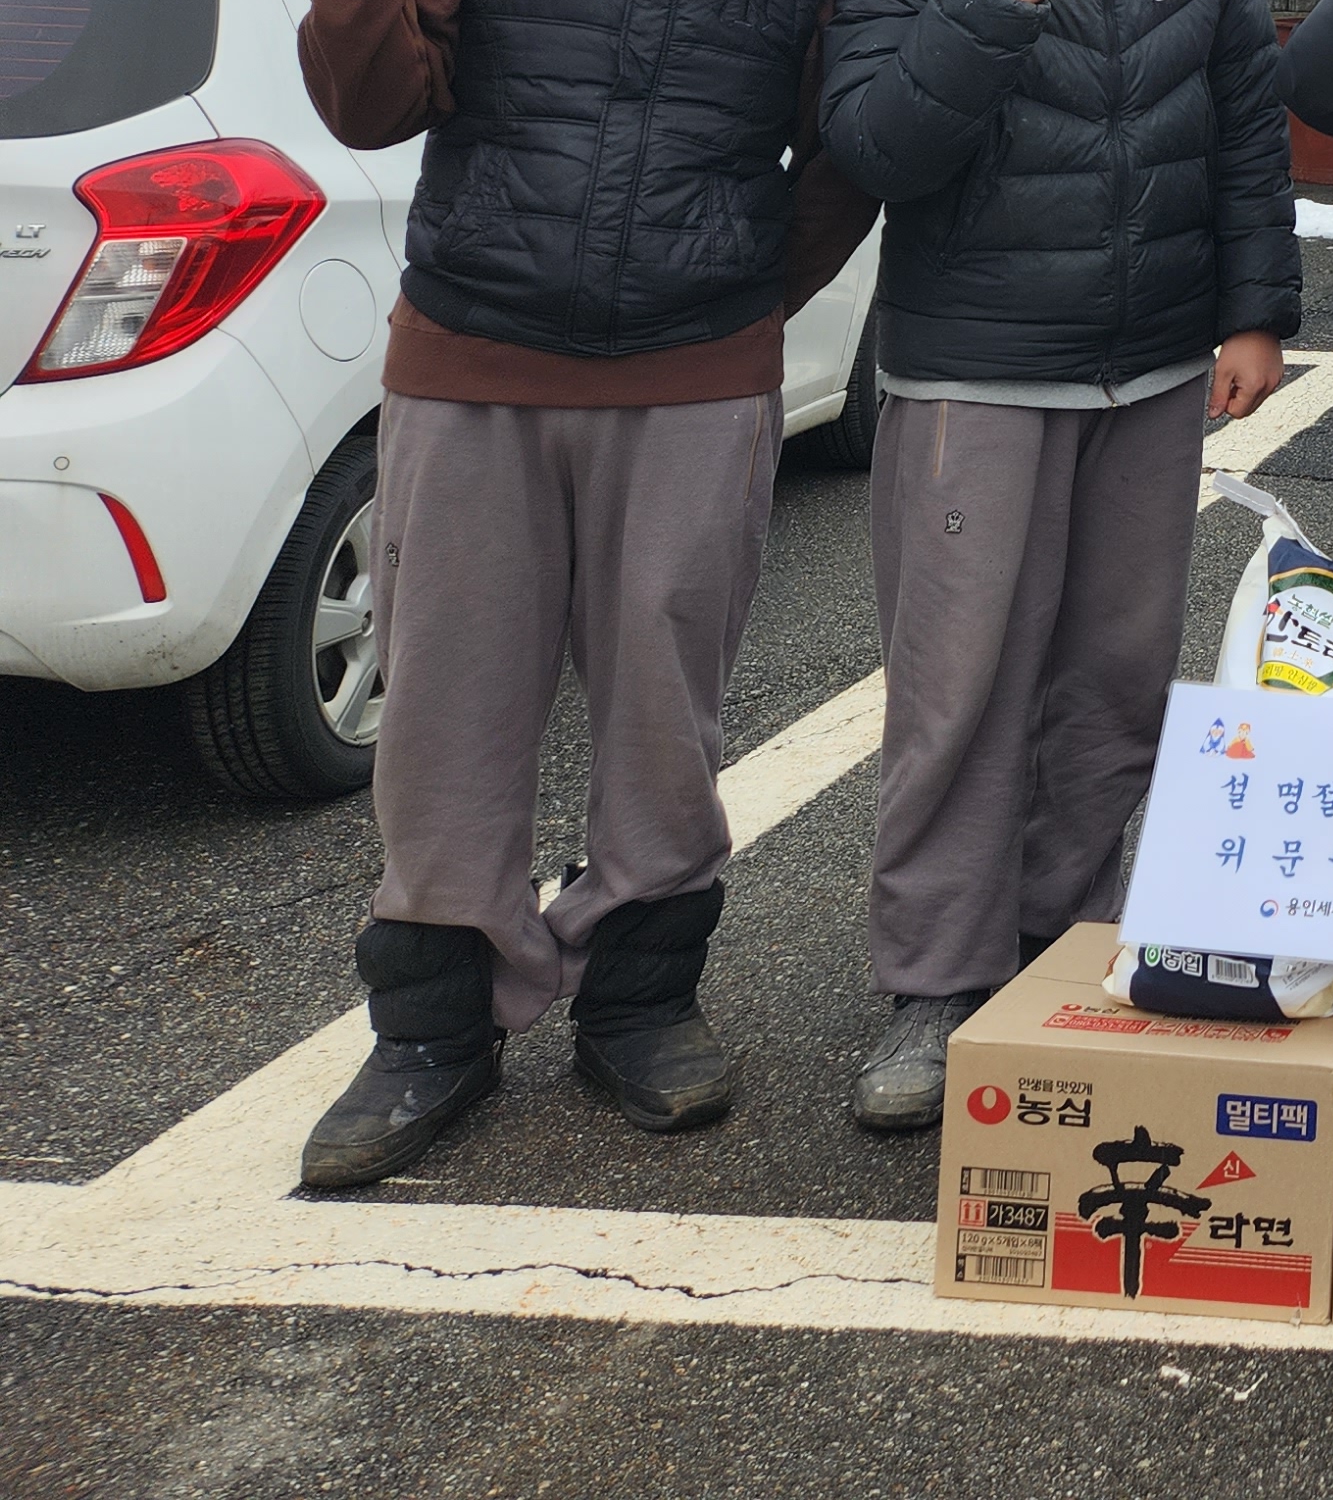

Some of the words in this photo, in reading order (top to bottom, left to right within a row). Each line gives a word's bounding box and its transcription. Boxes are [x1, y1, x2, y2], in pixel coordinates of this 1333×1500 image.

[15, 223, 47, 239] LT
[1220, 772, 1250, 810] 설
[1163, 946, 1202, 977] 농협
[1018, 1077, 1053, 1093] 인생을
[1056, 1080, 1093, 1096] 맛있게
[1016, 1092, 1093, 1129] 농심
[1226, 1099, 1309, 1139] 멀티팩
[1222, 1159, 1241, 1180] 신
[989, 1203, 1047, 1228] 가3487
[1078, 1124, 1213, 1301] 辛
[962, 1232, 981, 1244] 120
[1208, 1213, 1295, 1249] 라면
